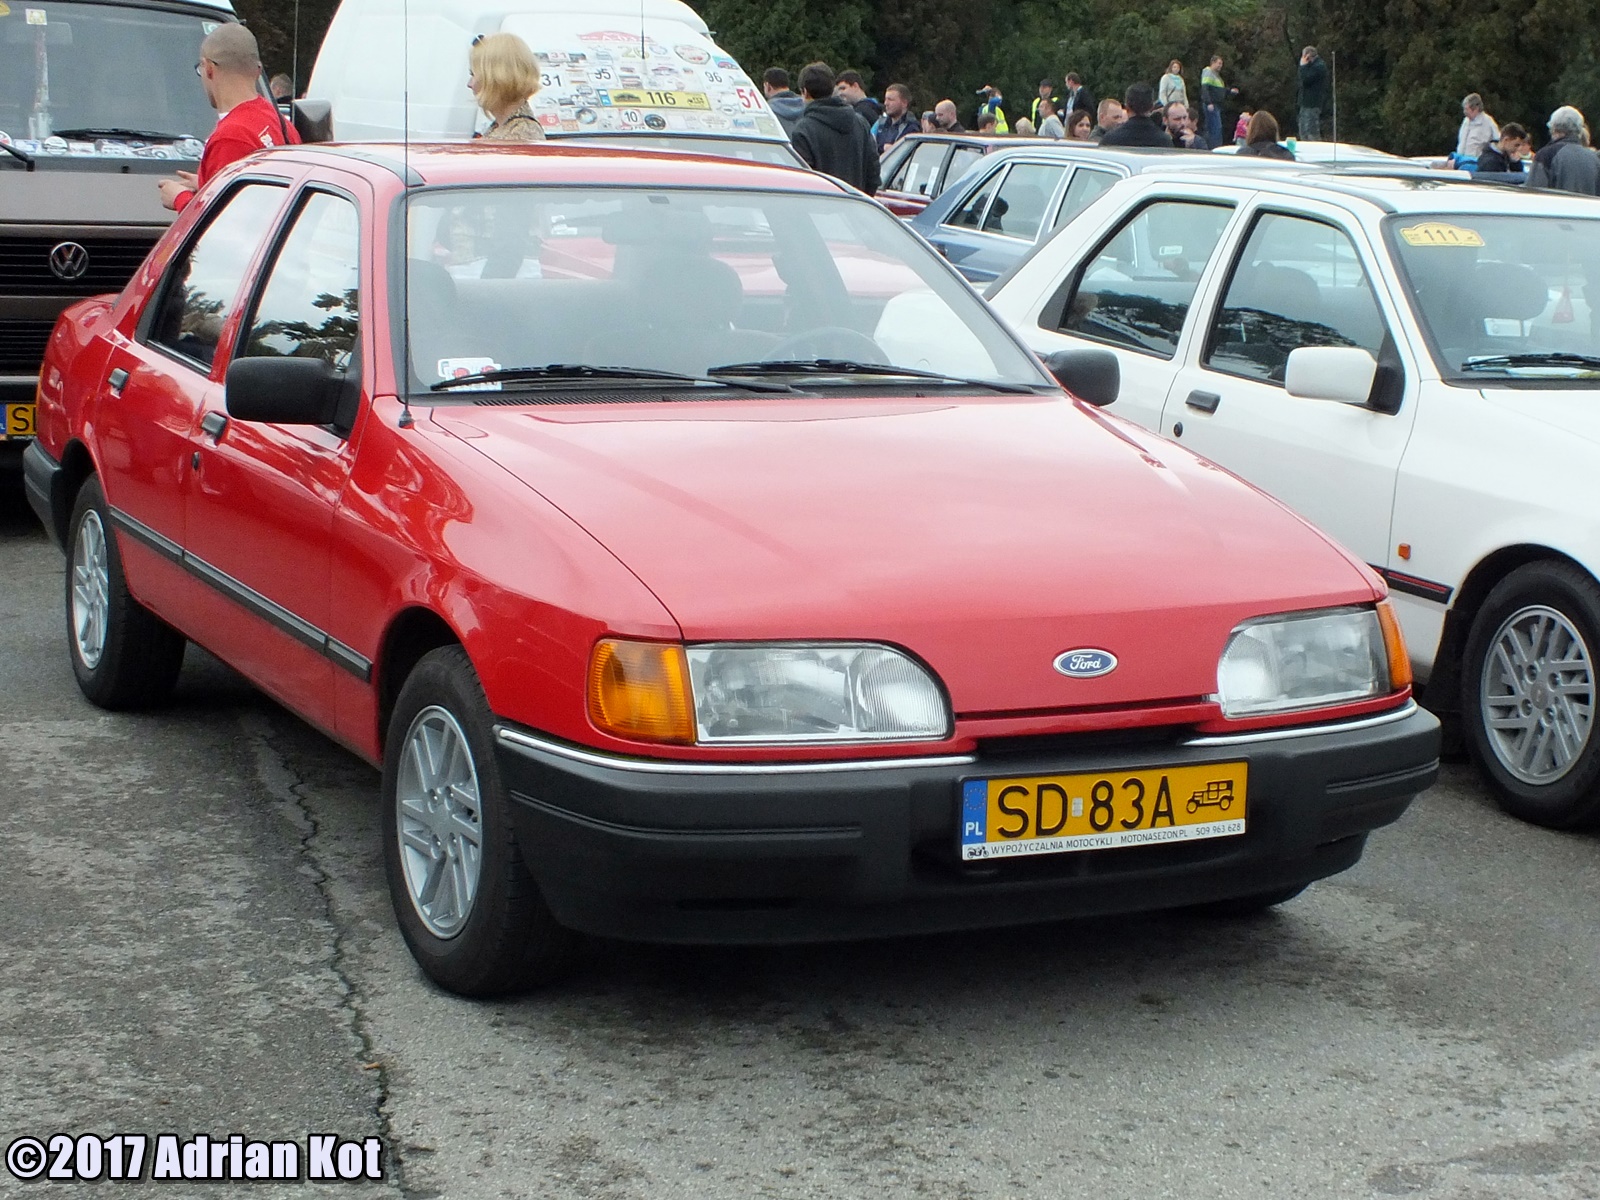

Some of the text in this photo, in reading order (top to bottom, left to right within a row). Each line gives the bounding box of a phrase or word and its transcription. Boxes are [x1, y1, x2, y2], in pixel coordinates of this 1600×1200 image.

[541, 73, 562, 87] 31
[704, 71, 723, 83] 96
[646, 91, 676, 106] 116
[736, 88, 762, 109] 51
[624, 111, 638, 123] 10
[1424, 229, 1459, 241] 111
[1069, 654, 1102, 670] Ford
[996, 775, 1176, 838] SD 83A
[965, 821, 983, 837] PL
[991, 839, 1064, 854] WYPOŻYCZALNIA
[1066, 837, 1113, 848] MOTOCYKLI
[1195, 827, 1210, 836] 509
[1212, 824, 1226, 833] 963
[1227, 822, 1242, 832] 628
